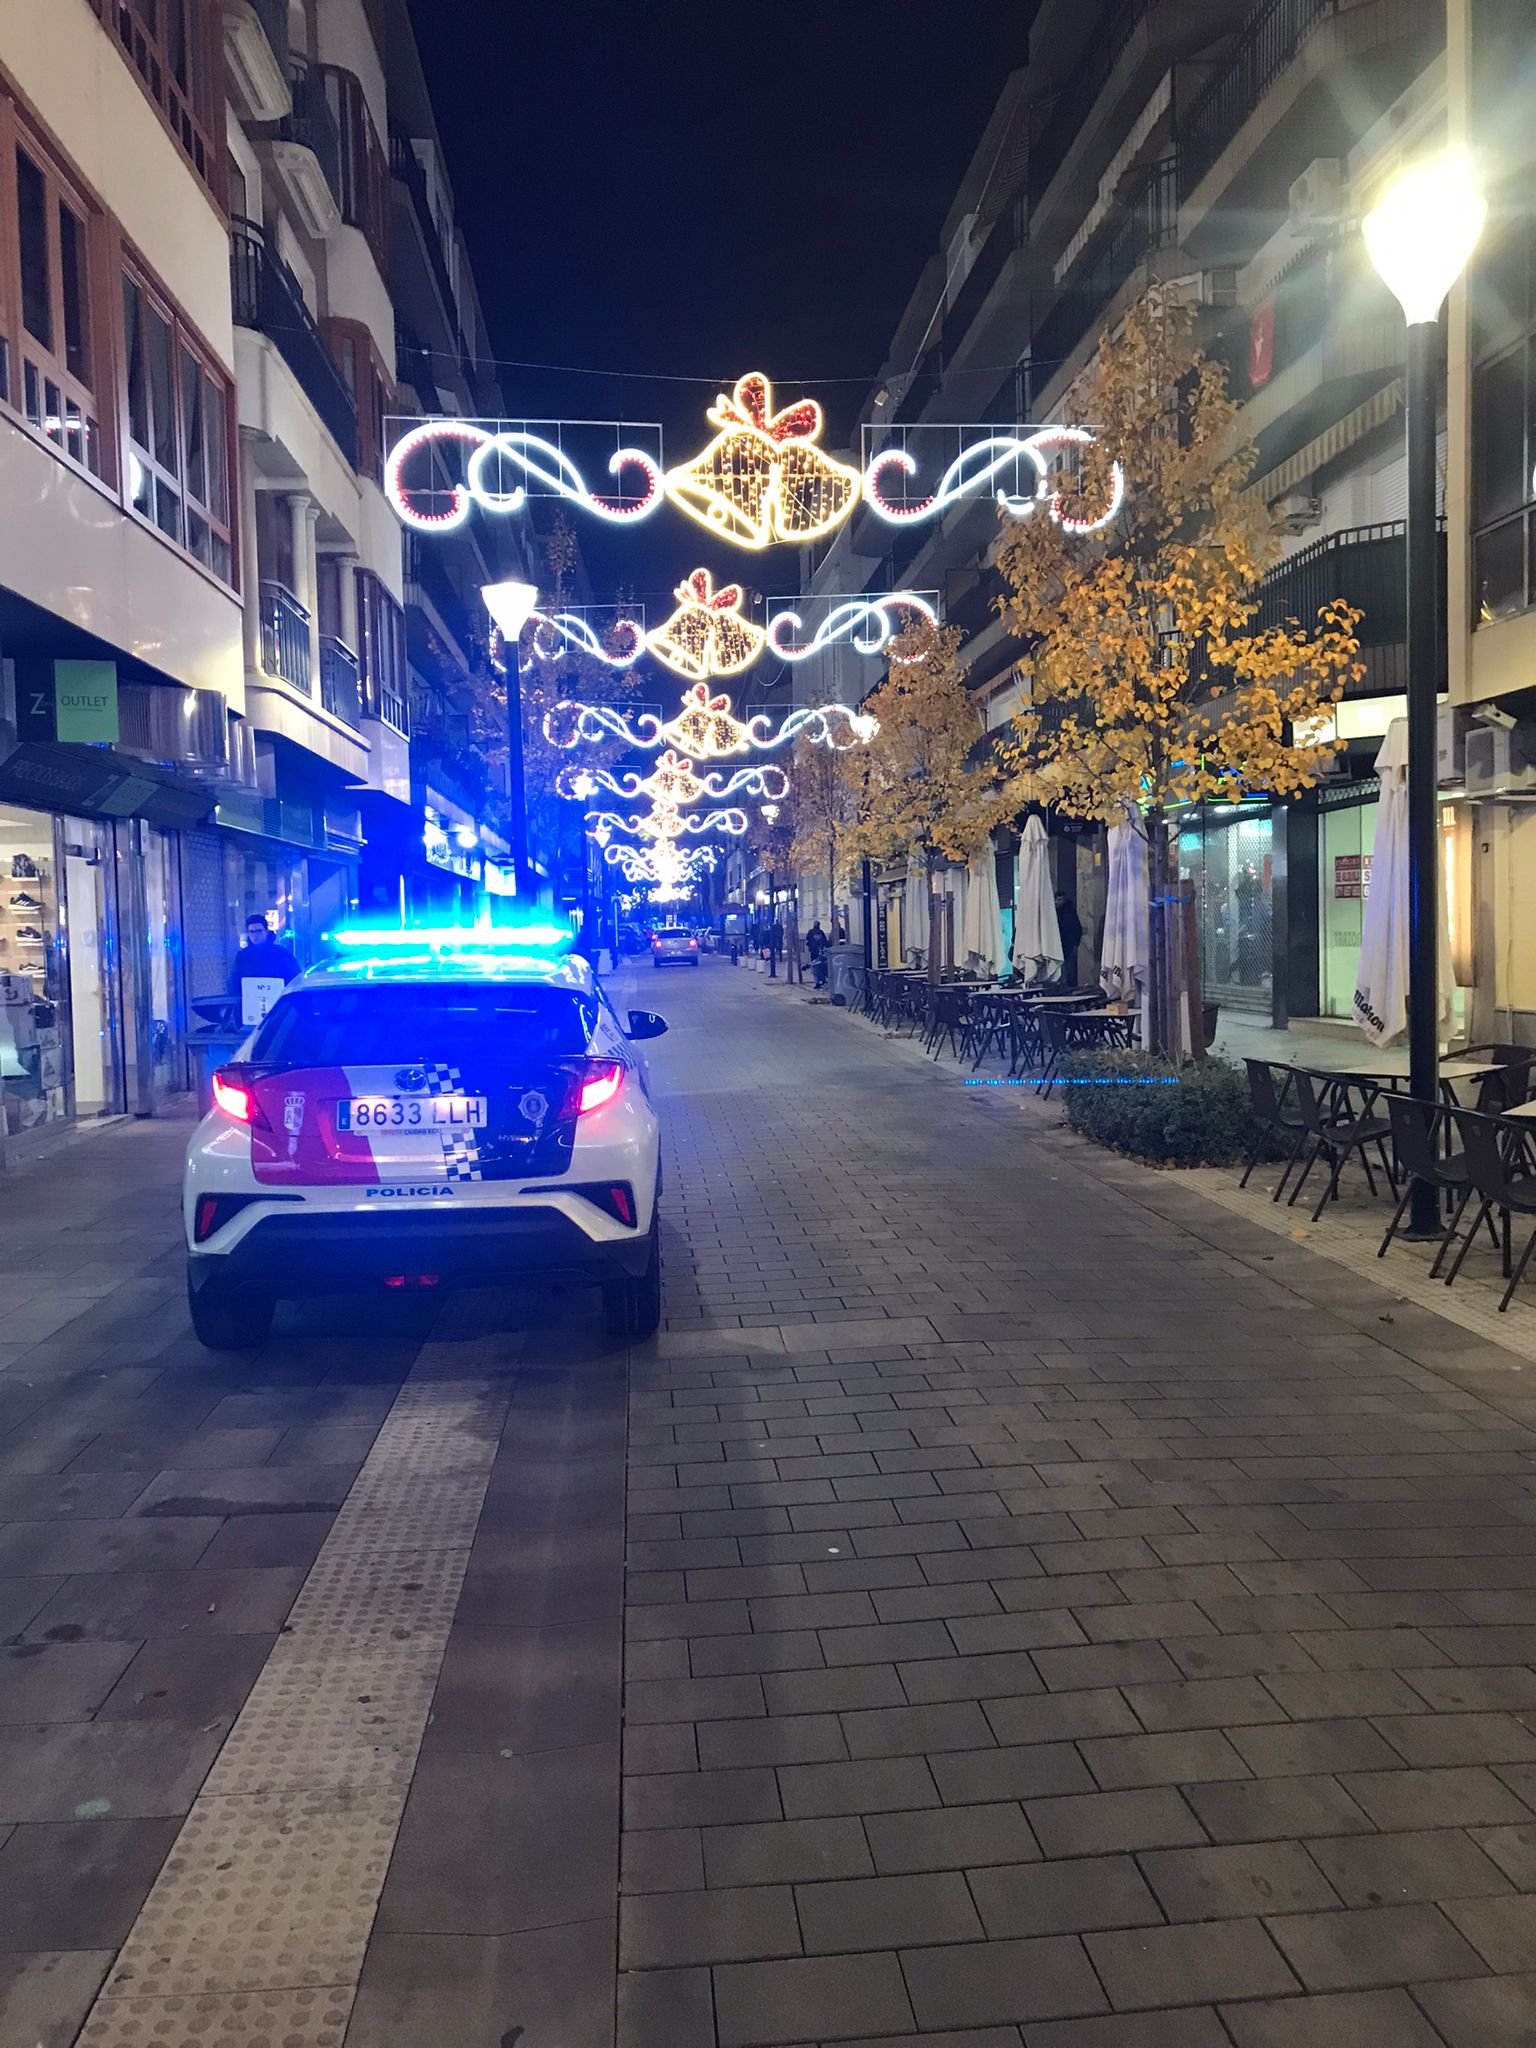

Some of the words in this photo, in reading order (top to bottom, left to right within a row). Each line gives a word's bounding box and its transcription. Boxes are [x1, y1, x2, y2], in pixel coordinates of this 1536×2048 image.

[61, 695, 109, 708] OUTLET
[356, 1103, 423, 1126] 8633
[432, 1101, 482, 1125] LLH
[366, 1186, 454, 1198] POLICÍA
